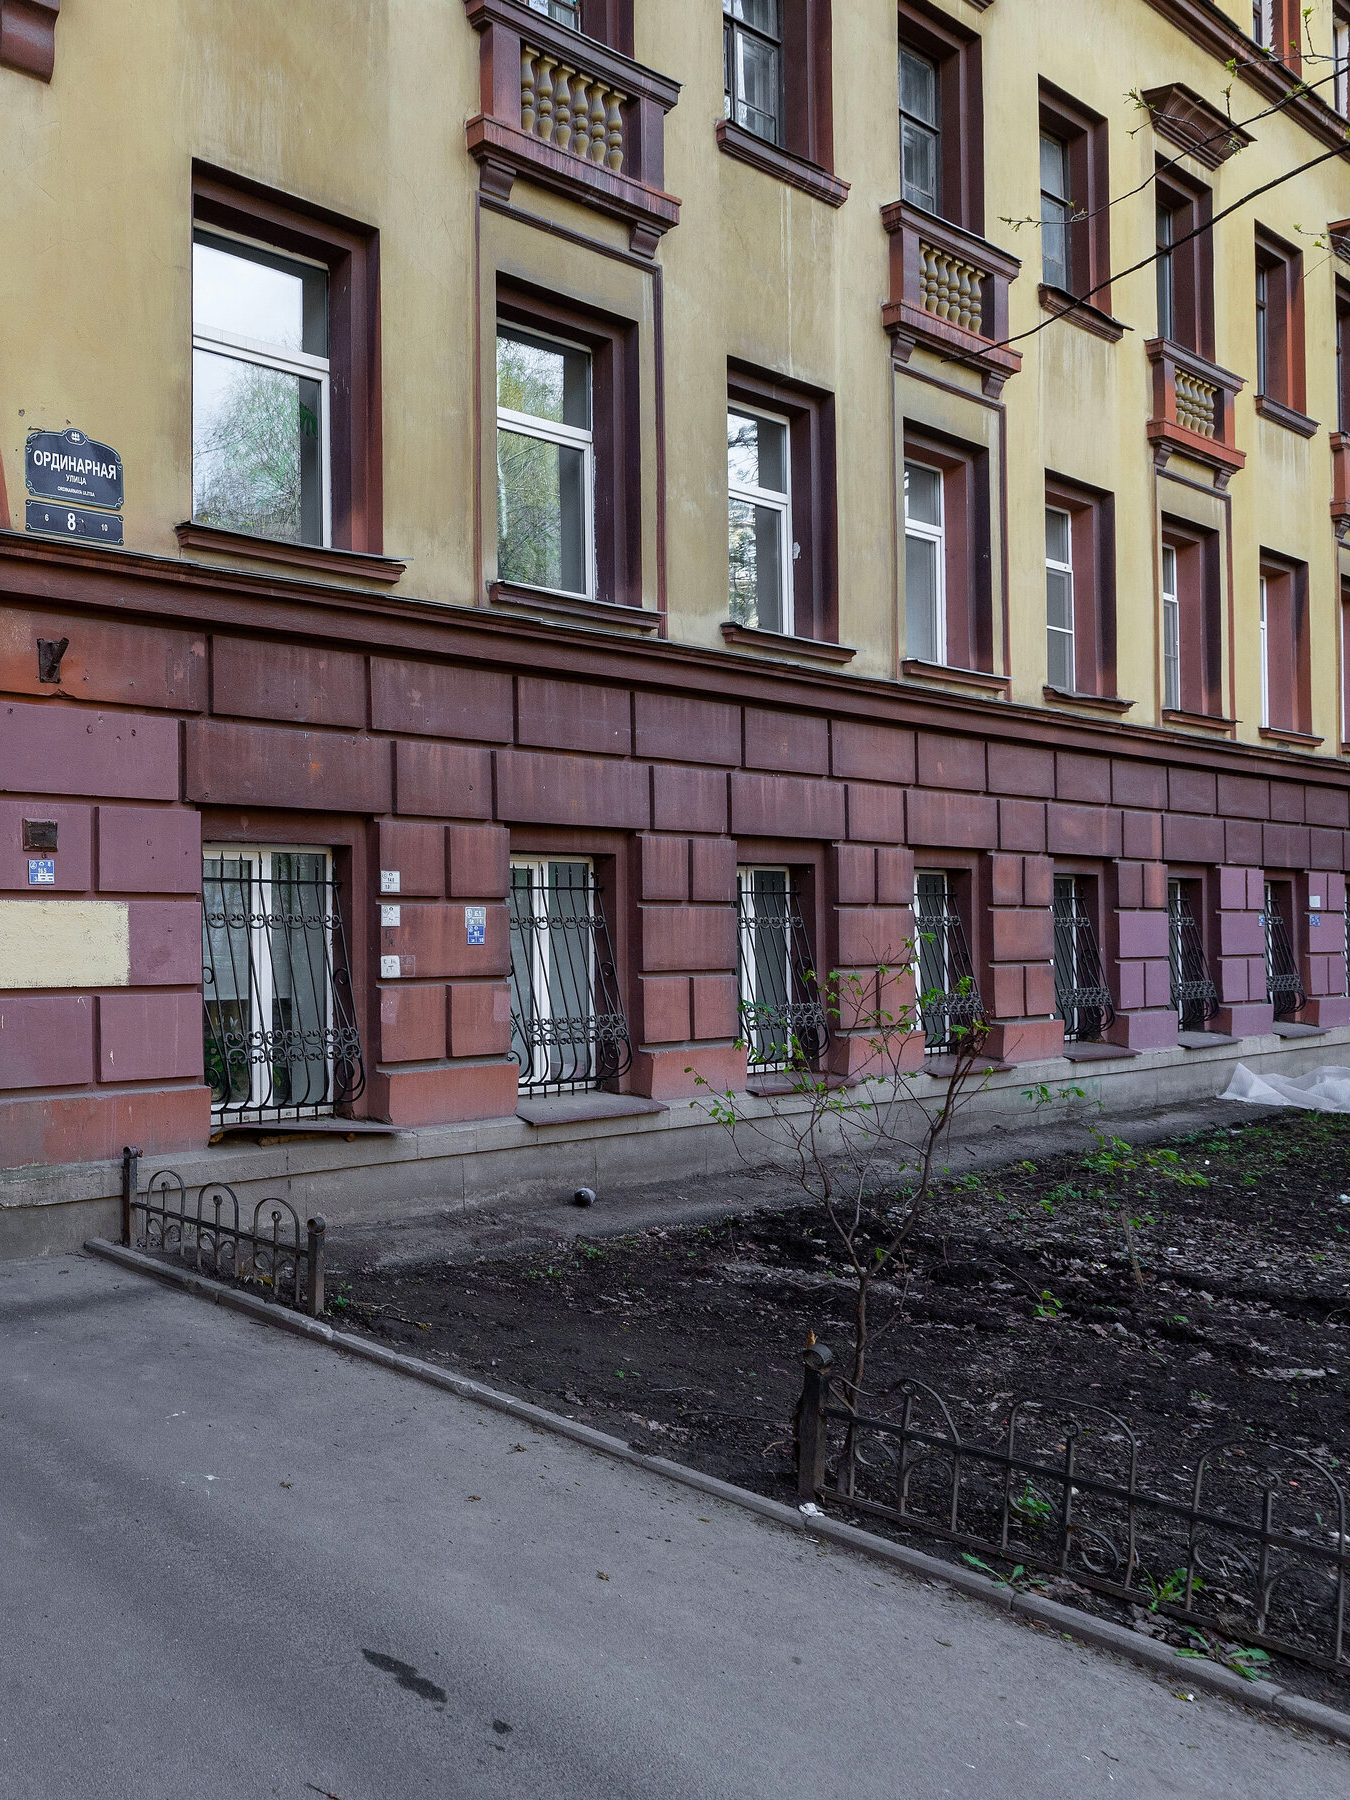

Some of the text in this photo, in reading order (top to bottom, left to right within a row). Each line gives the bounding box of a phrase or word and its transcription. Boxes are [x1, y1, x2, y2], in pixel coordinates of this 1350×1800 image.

[33, 450, 117, 480] ОРДИНАРНАЯ
[65, 473, 87, 486] УЛИЦА
[44, 512, 109, 532] 6 8 10
